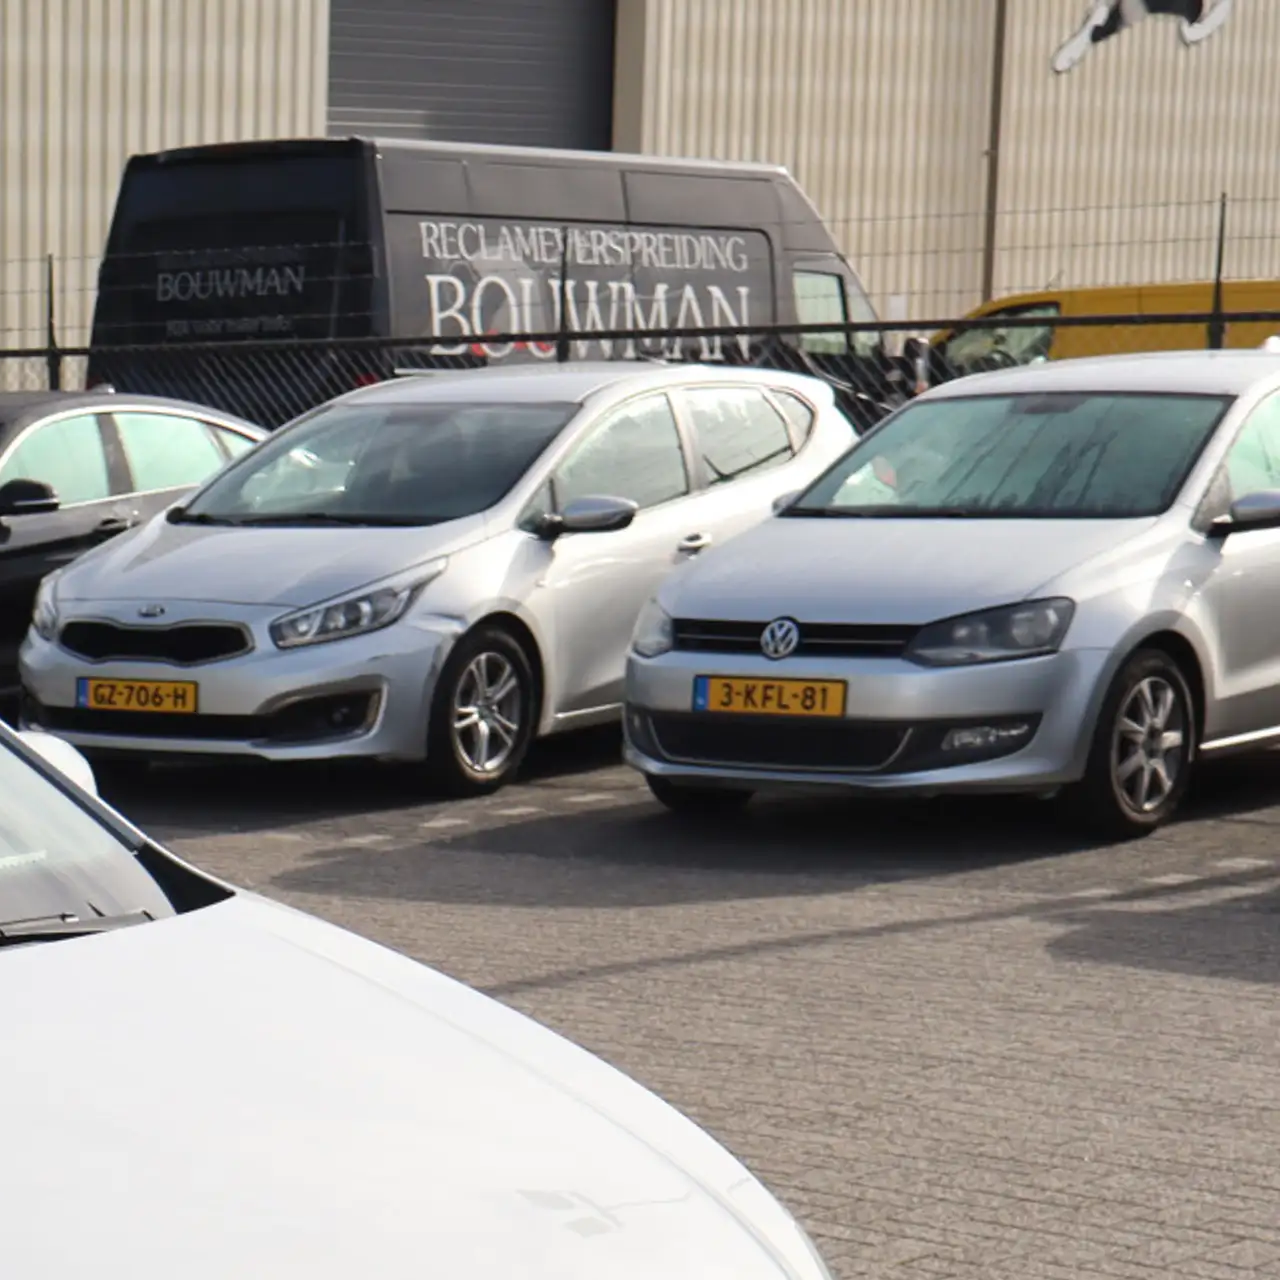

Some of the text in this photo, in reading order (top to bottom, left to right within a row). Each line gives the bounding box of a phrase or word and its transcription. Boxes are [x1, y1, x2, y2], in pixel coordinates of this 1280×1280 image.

[419, 221, 749, 271] RECLAMEVERSPREIDING
[155, 265, 306, 302] BOUWMAN
[425, 274, 751, 361] BOUWMAN
[92, 682, 188, 709] GZ-706-H
[719, 682, 830, 711] 3-KFL-81
